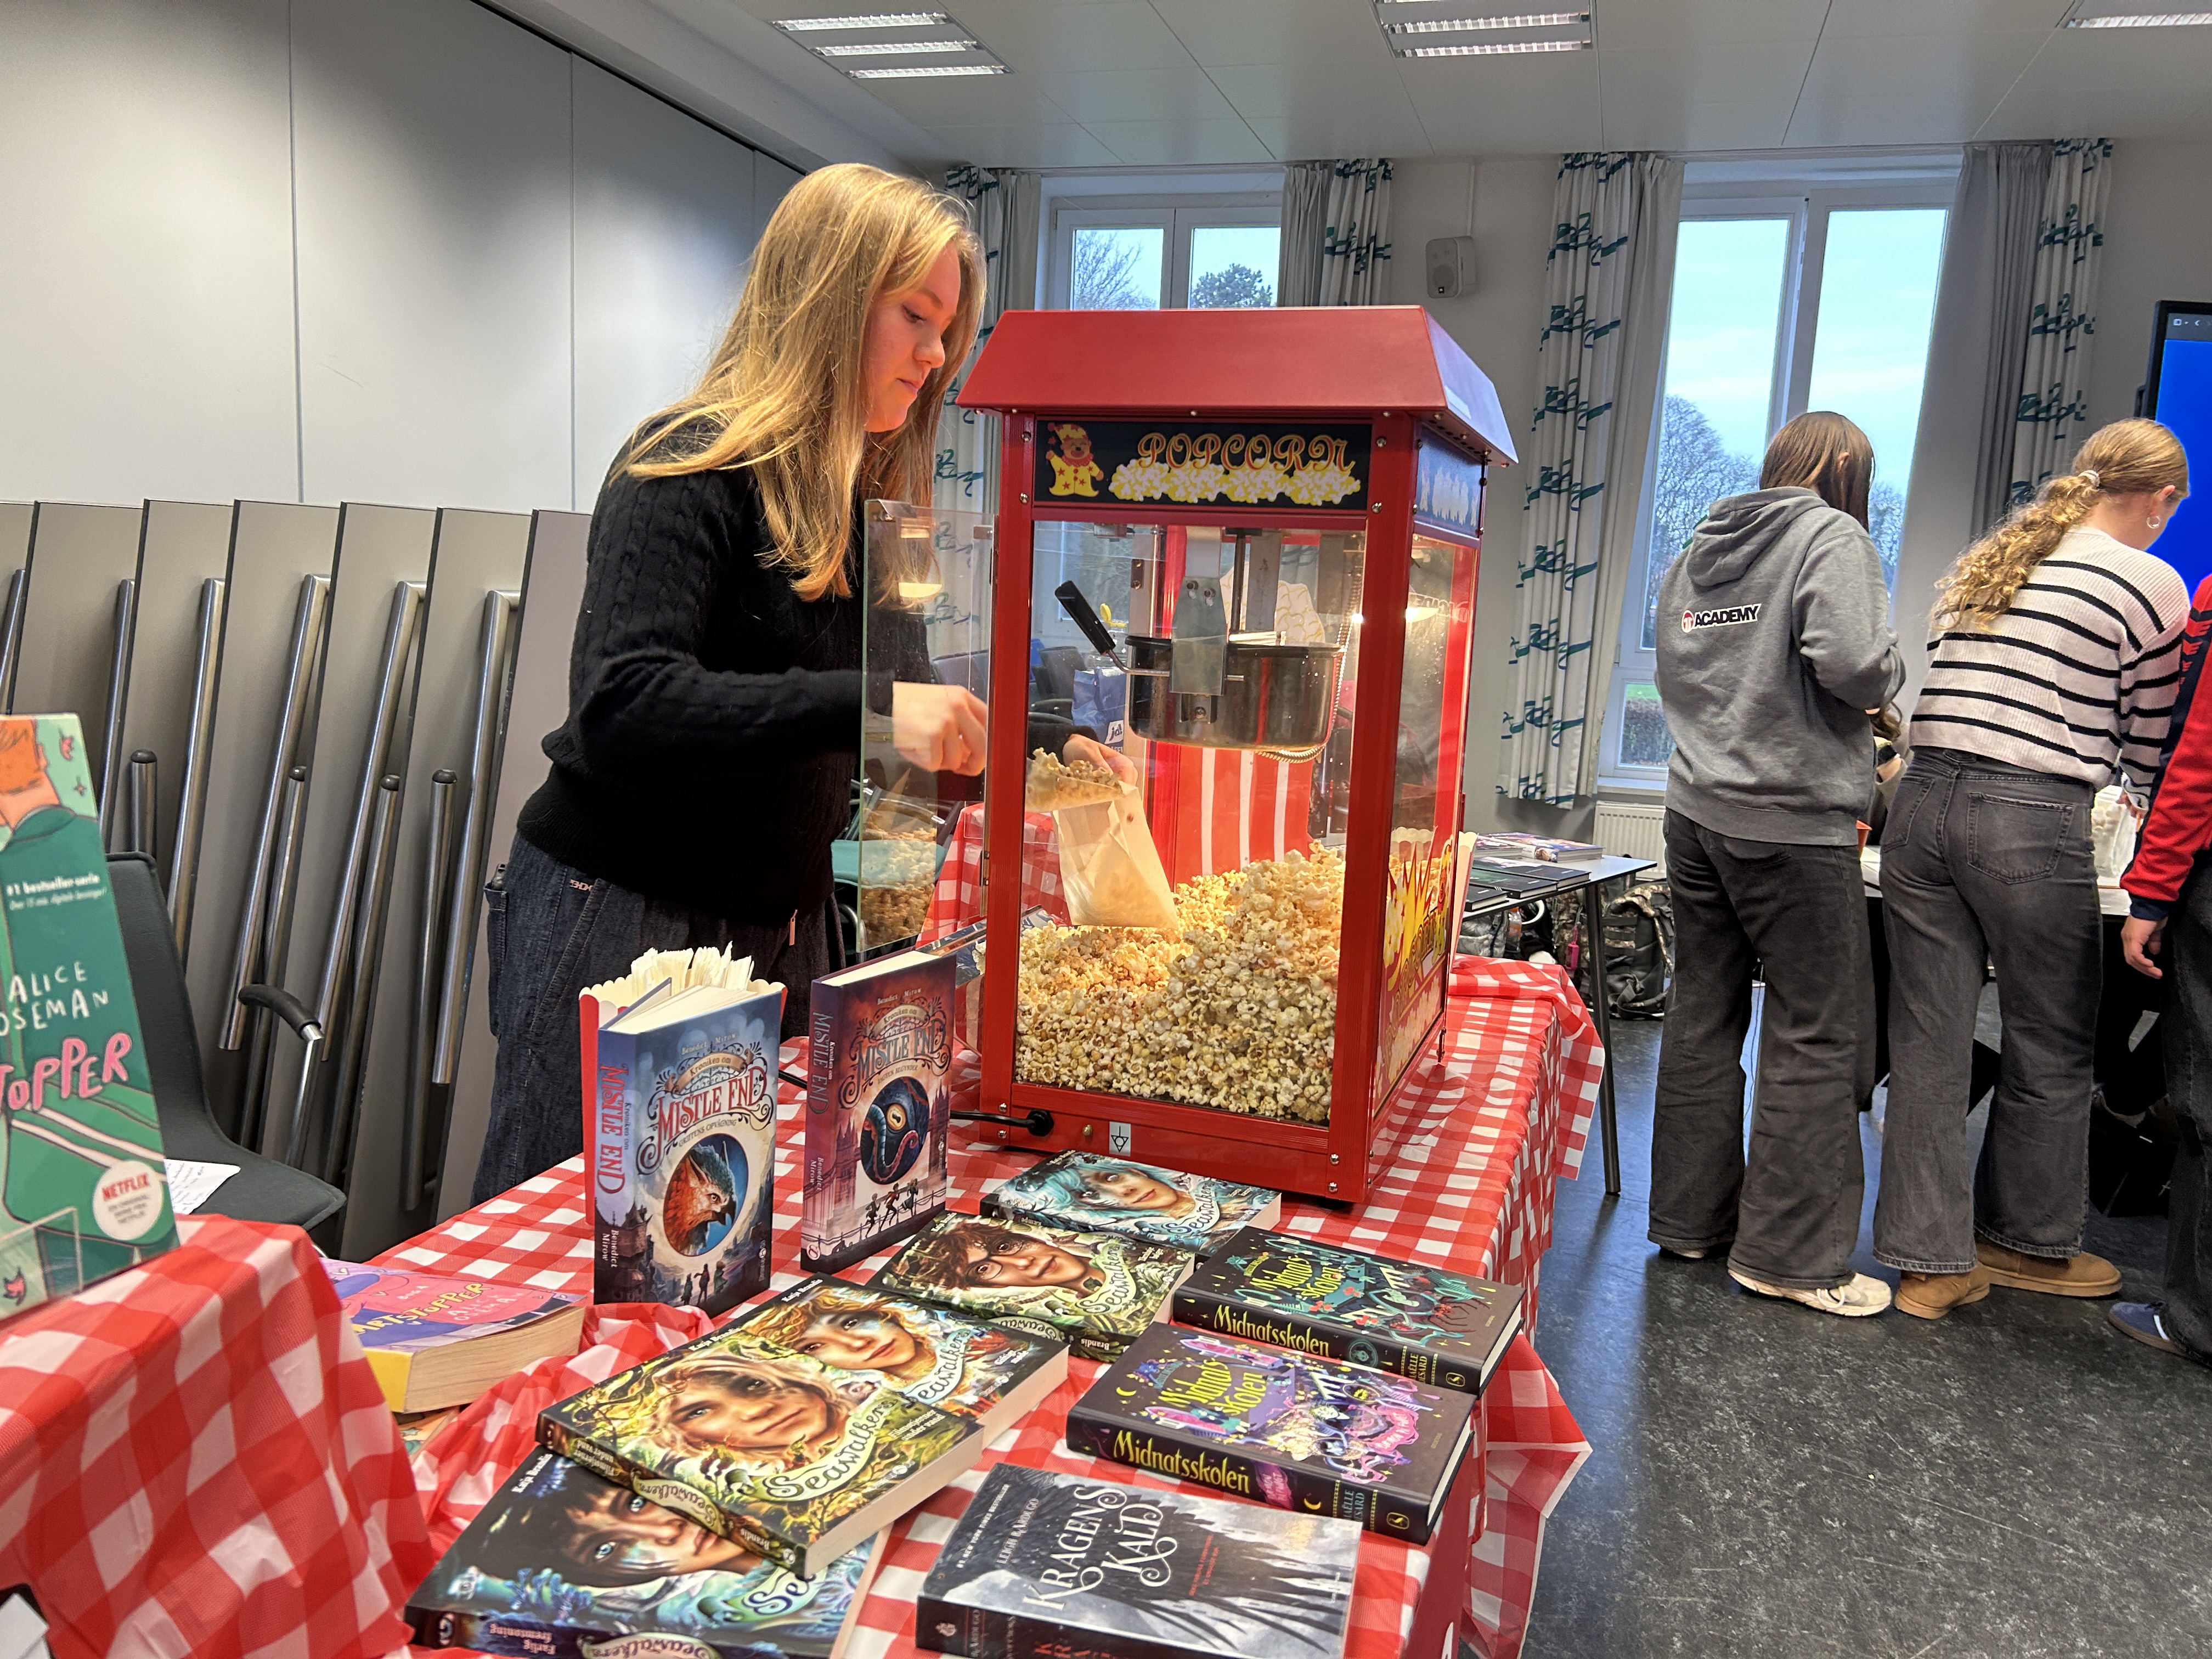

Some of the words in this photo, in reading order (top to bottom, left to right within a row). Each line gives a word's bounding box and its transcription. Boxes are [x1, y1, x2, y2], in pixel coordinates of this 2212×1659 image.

[1136, 431, 1356, 473] POPCORN
[1695, 606, 1758, 627] ACADEMY
[9, 962, 88, 1004] ALICE
[813, 1011, 833, 1065] MISTLE
[914, 1018, 946, 1056] END
[690, 1057, 720, 1076] Kroniken
[600, 1064, 629, 1136] MISTLE
[728, 1066, 767, 1110] END
[809, 1073, 829, 1114] END
[101, 1172, 150, 1201] NETFLIX
[597, 1144, 626, 1194] END
[1165, 1178, 1216, 1233] Seawalkers
[602, 1233, 610, 1262] Mirow
[611, 1229, 619, 1268] Benedict
[781, 1287, 804, 1303] Katja
[799, 1278, 823, 1294] Brandis
[1075, 1244, 1136, 1313] Seawalkers
[689, 1339, 712, 1352] Katja
[711, 1327, 742, 1342] Brandis
[1081, 1338, 1110, 1351] Brandis
[1214, 1304, 1330, 1357] Midnatsskolen
[900, 1329, 972, 1406] eawalkers
[576, 1438, 594, 1452] vand
[592, 1447, 614, 1464] under
[763, 1398, 898, 1498] Seawalkers
[1114, 1429, 1250, 1494] Midnatsskolen
[511, 1473, 532, 1493] Katja
[530, 1453, 554, 1476] Brandis
[637, 1482, 715, 1528] Seawalkers
[1353, 1492, 1365, 1522] ESARD
[741, 1527, 770, 1550] Brandis
[996, 1534, 1020, 1565] LEIGH
[1023, 1487, 1127, 1610] KRAGENS
[1100, 1503, 1178, 1587] KALD
